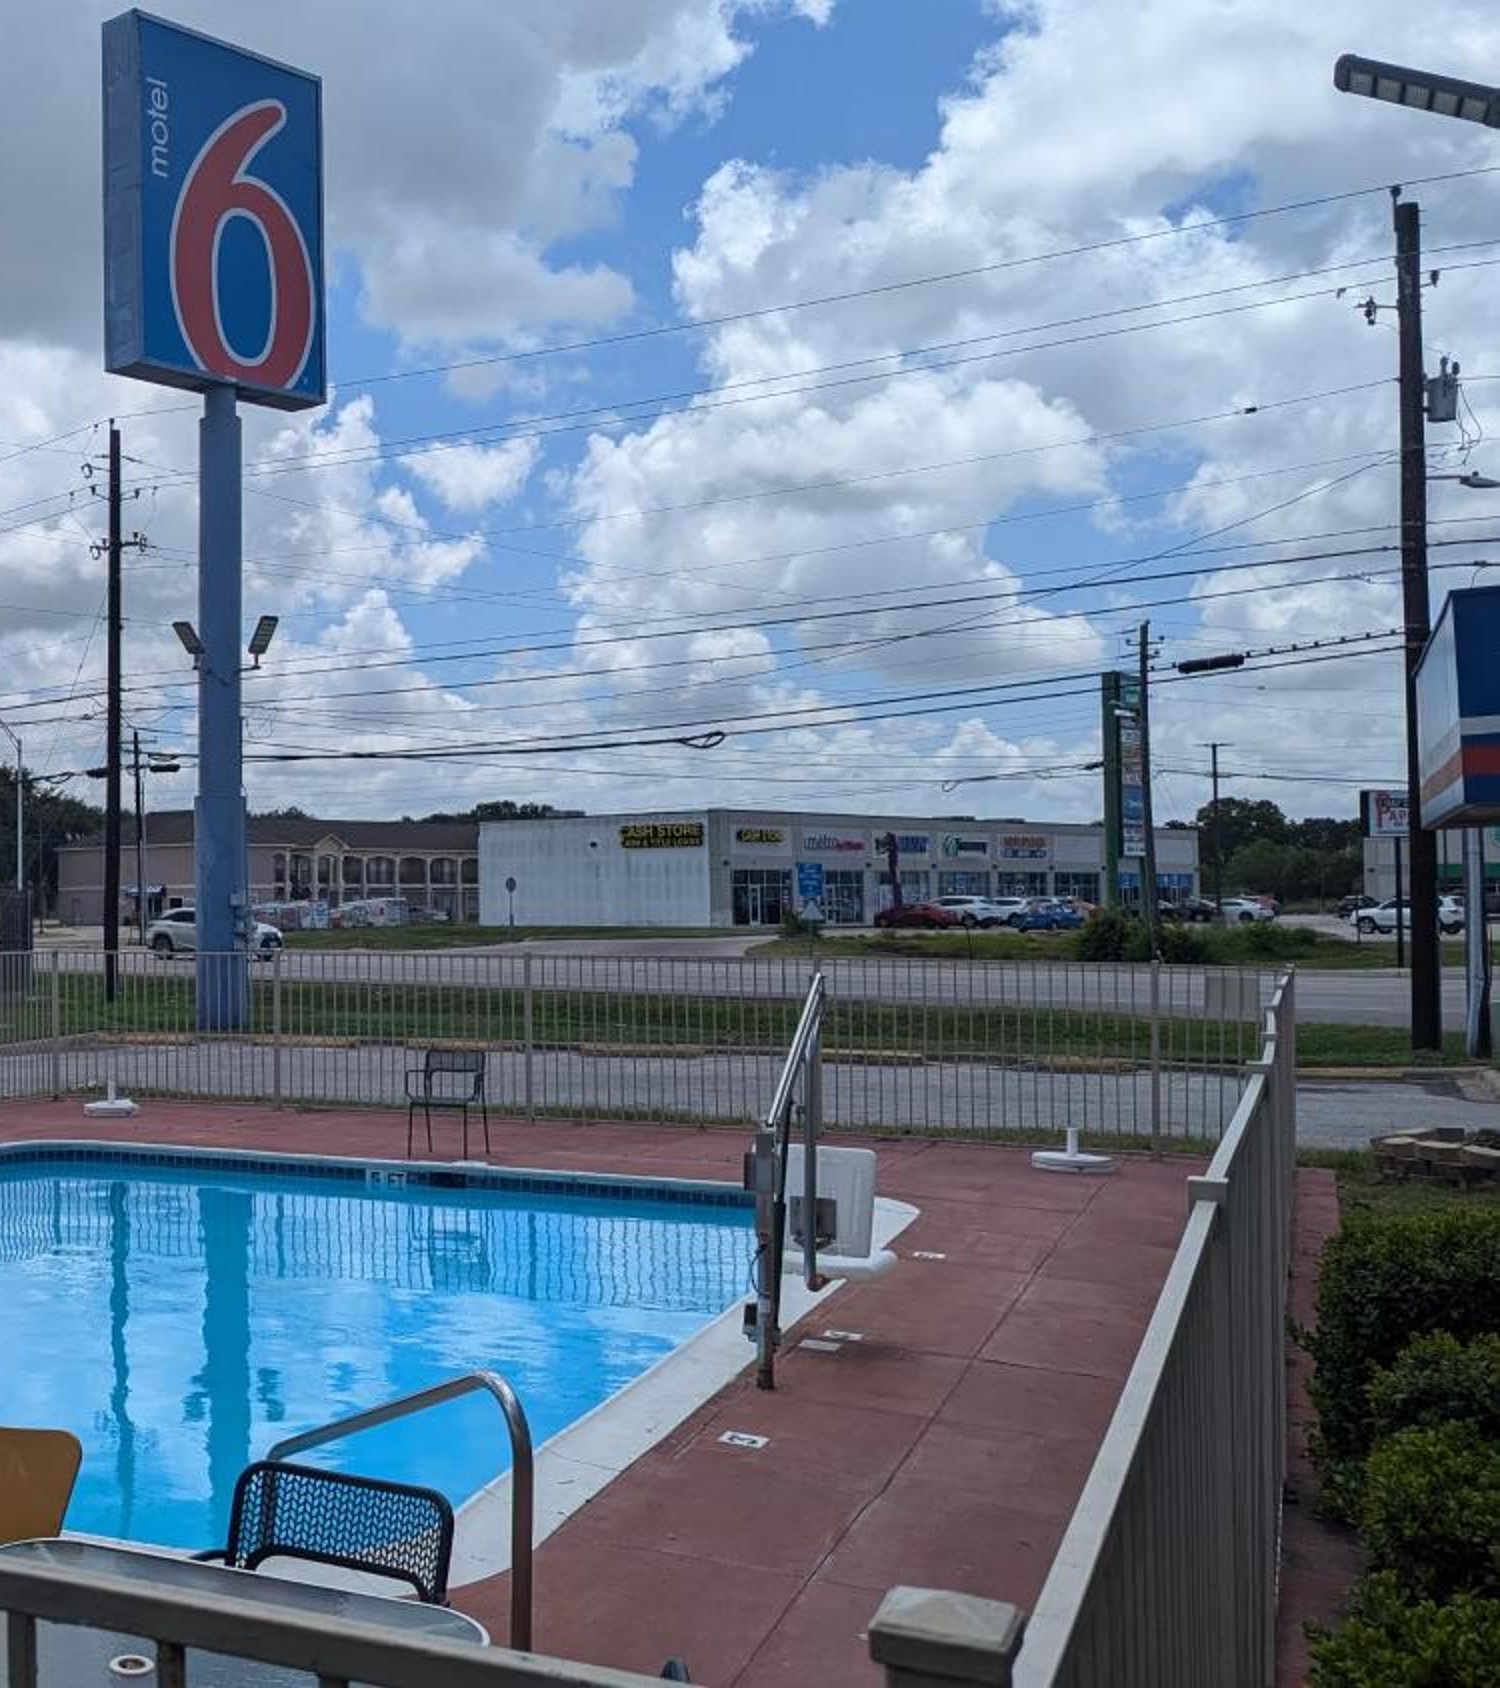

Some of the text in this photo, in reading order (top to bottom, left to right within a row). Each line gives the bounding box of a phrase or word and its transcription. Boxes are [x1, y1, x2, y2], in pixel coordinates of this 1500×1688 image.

[145, 78, 170, 179] motel
[170, 98, 316, 391] 6
[657, 821, 702, 837] STORE
